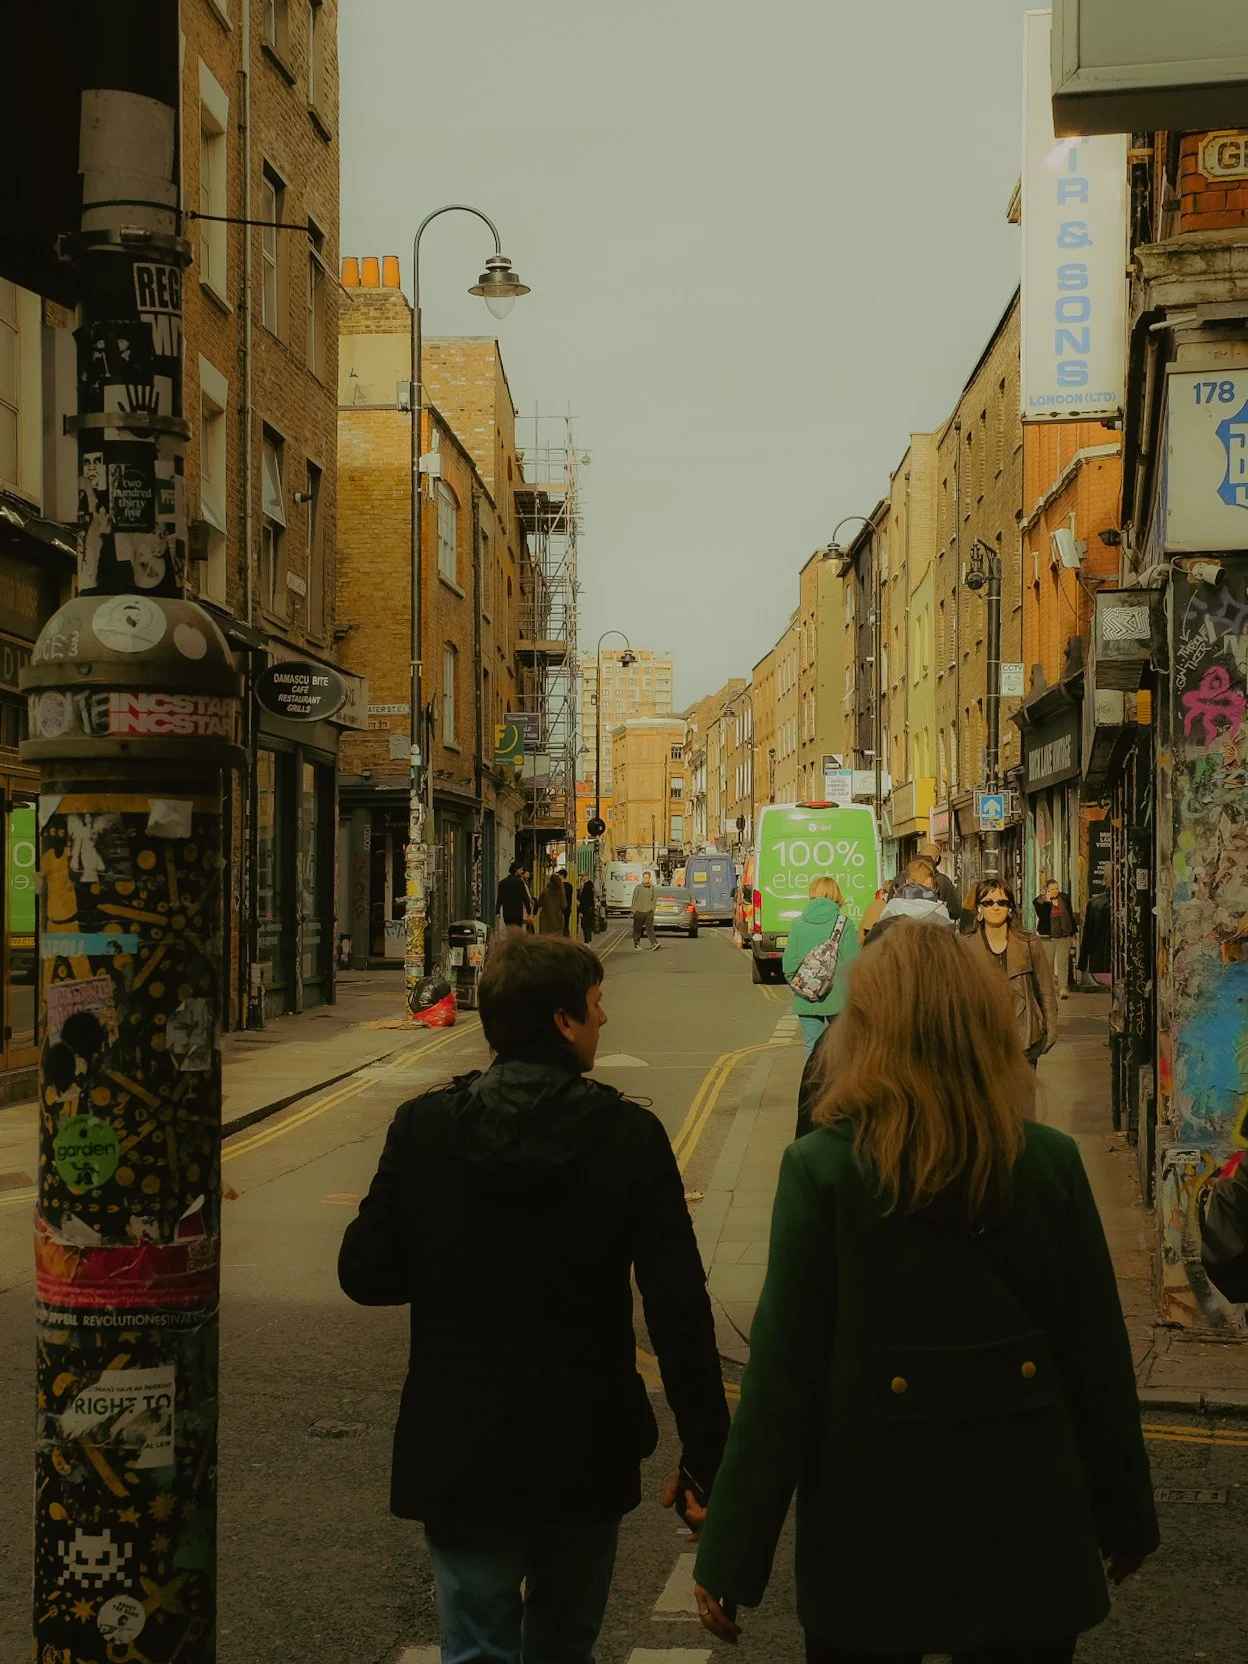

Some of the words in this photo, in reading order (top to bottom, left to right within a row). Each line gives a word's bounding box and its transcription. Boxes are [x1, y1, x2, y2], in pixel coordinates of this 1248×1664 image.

[1055, 263, 1092, 388] SONS
[1193, 380, 1235, 405] 178
[121, 479, 142, 488] two
[118, 498, 147, 509] thirty
[273, 673, 310, 685] DAMASCU
[312, 676, 329, 686] BITE
[278, 694, 322, 704] RESTAURANT
[286, 704, 311, 714] GRILLS
[772, 840, 865, 867] 100%
[610, 871, 639, 882] FedEx
[57, 1141, 116, 1161] garden
[75, 1398, 137, 1415] RIGHT
